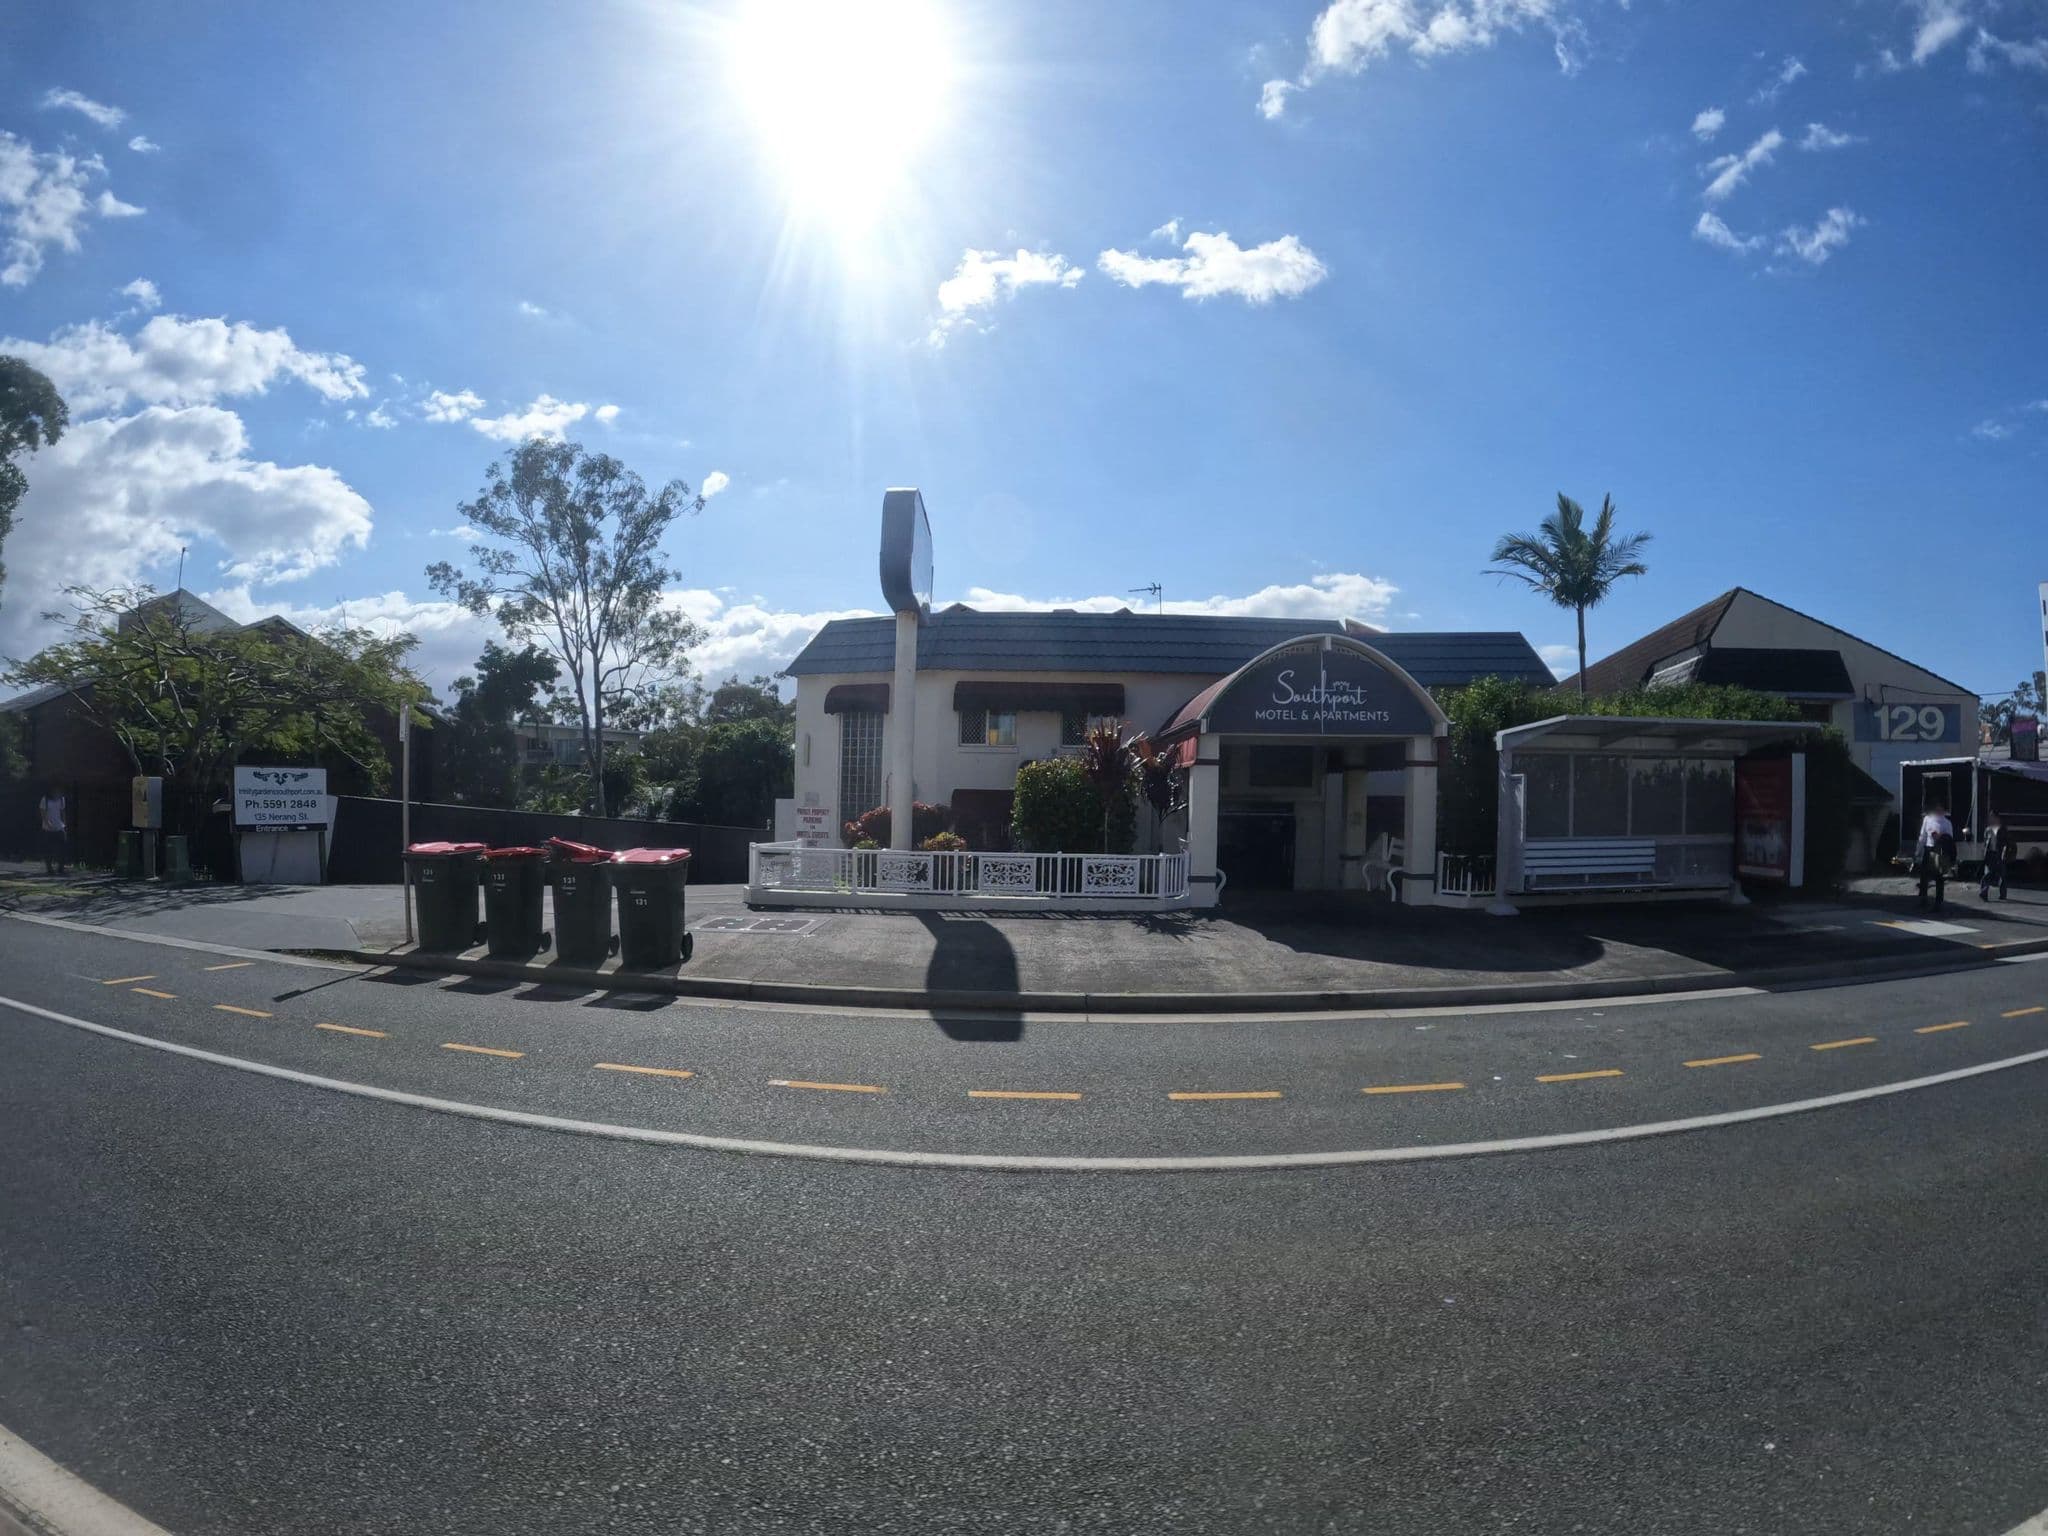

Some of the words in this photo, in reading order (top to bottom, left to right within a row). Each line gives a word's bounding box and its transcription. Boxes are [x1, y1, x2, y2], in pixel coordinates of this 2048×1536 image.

[1272, 669, 1368, 713] Southport
[1255, 709, 1297, 721] MOTEL
[1301, 710, 1309, 721] &
[1313, 710, 1390, 722] APARTMENTS
[1873, 704, 1945, 741] 129
[290, 799, 317, 809] 2848
[268, 812, 297, 823] Nerang
